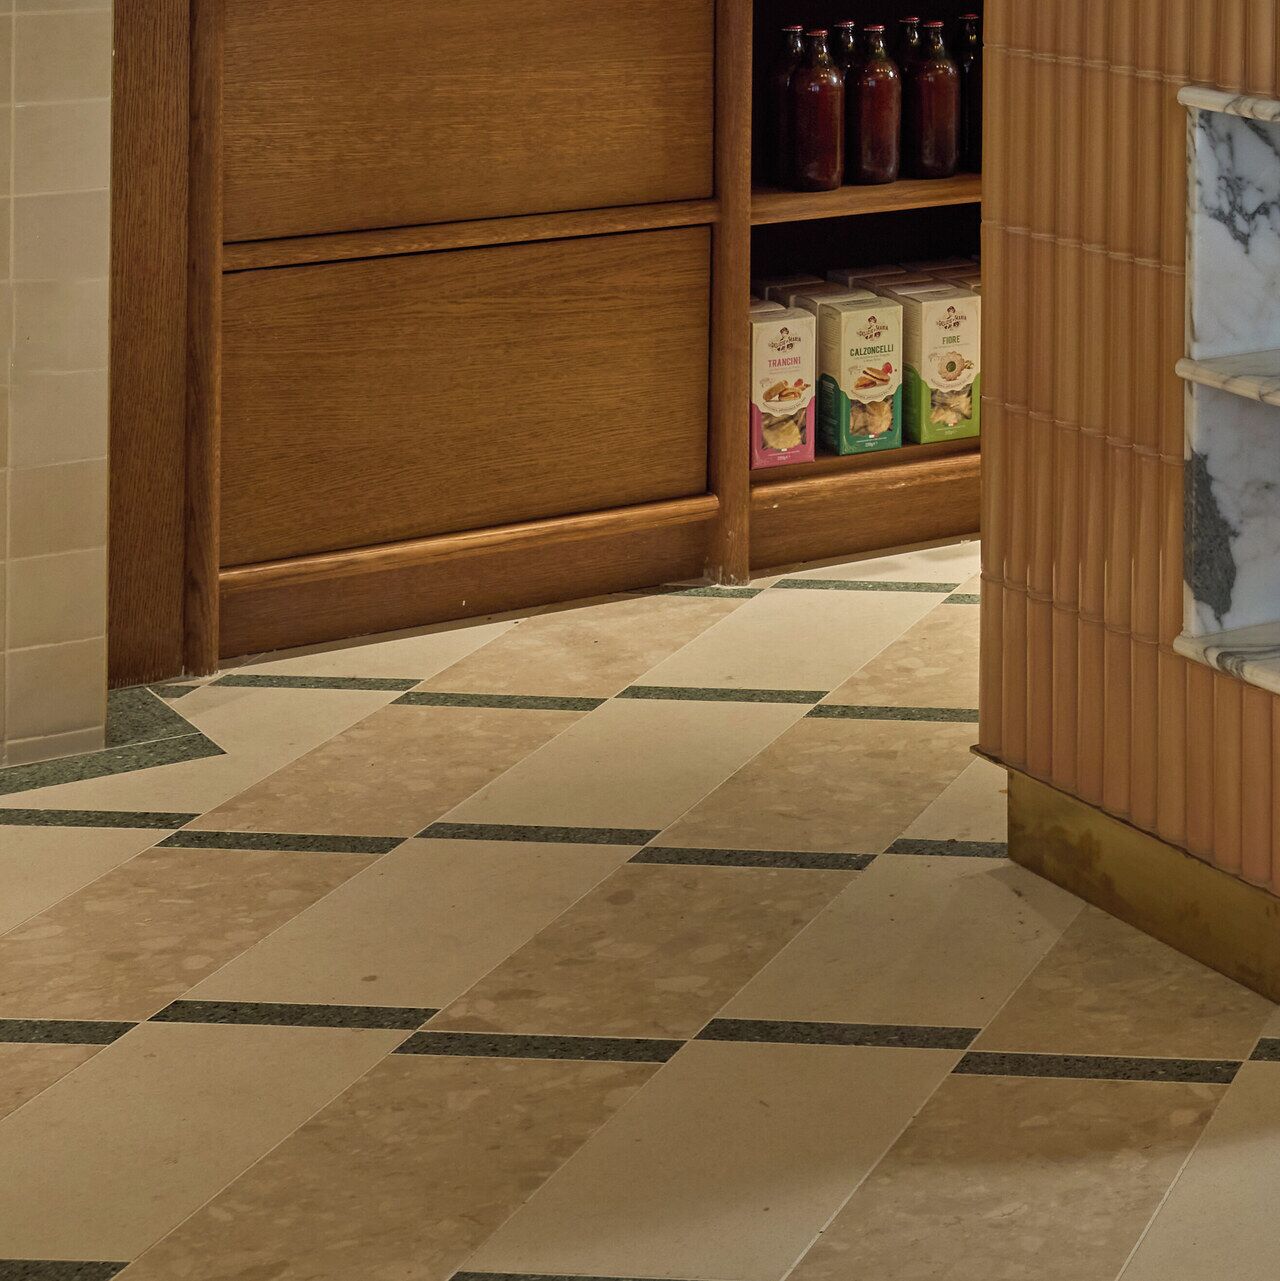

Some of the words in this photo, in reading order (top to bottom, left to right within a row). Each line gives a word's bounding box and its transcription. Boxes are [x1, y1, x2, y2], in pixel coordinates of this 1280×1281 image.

[942, 335, 961, 345] FIORE
[850, 343, 894, 357] CALZONCELLI
[768, 356, 801, 368] TRANCINI
